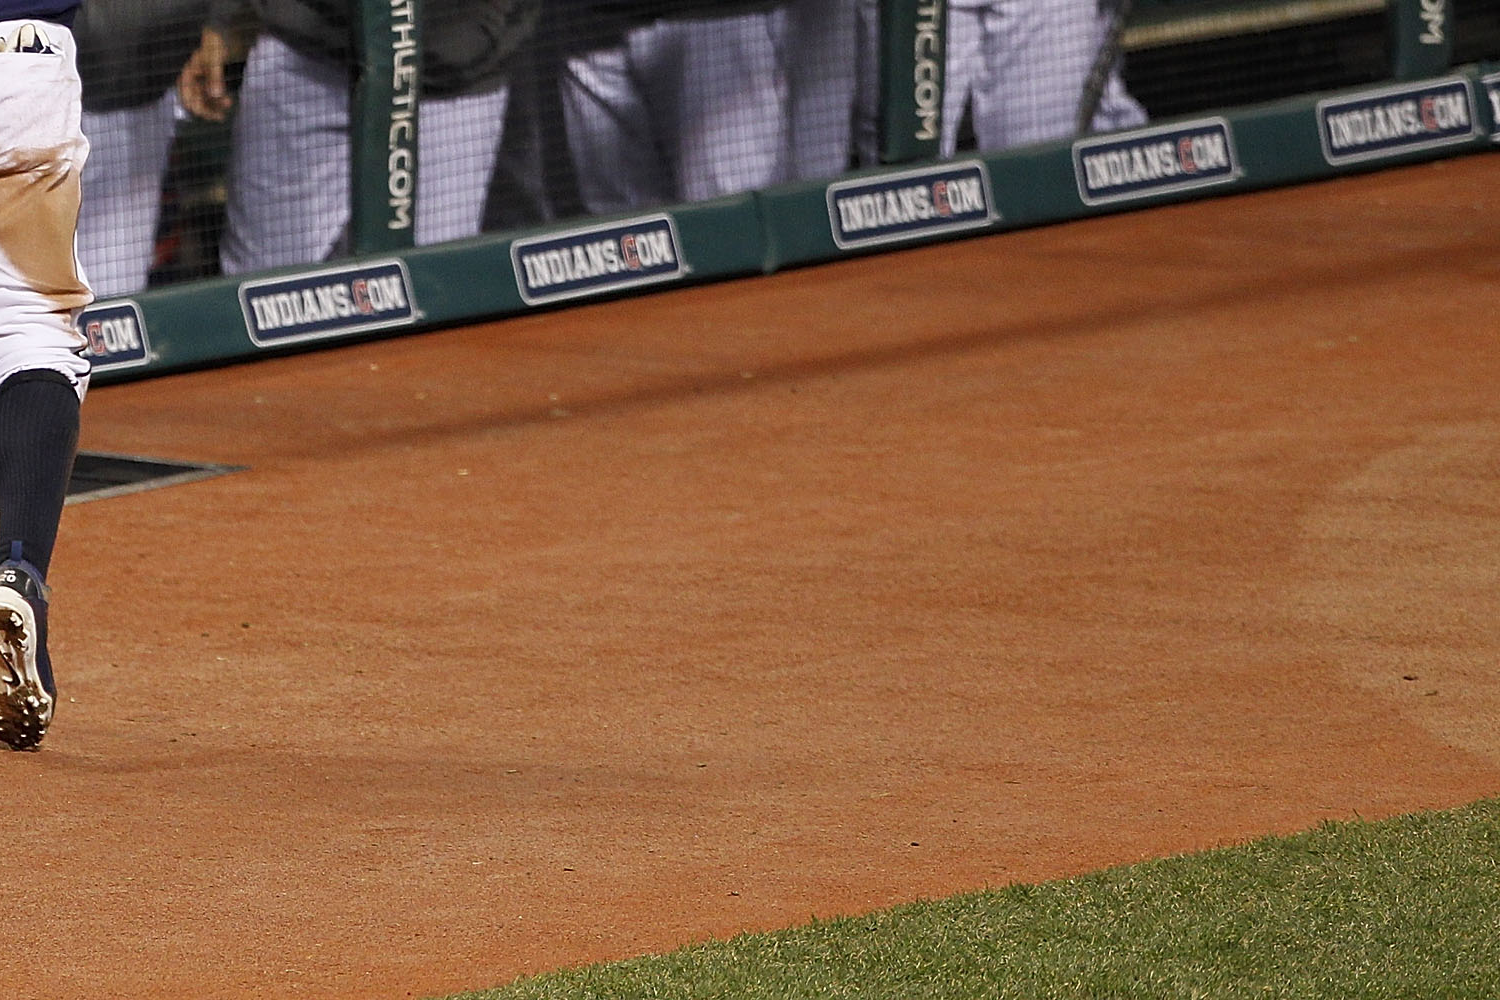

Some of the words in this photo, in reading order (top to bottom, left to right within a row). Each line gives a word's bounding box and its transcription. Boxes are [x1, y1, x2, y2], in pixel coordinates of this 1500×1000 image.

[1327, 90, 1469, 149] INDIANS.COM
[1082, 132, 1228, 191] INDIANS.COM
[836, 175, 985, 233] INDIANS.COM
[522, 229, 675, 289] INDIANS.COM
[250, 275, 406, 332] INDIANS.COM
